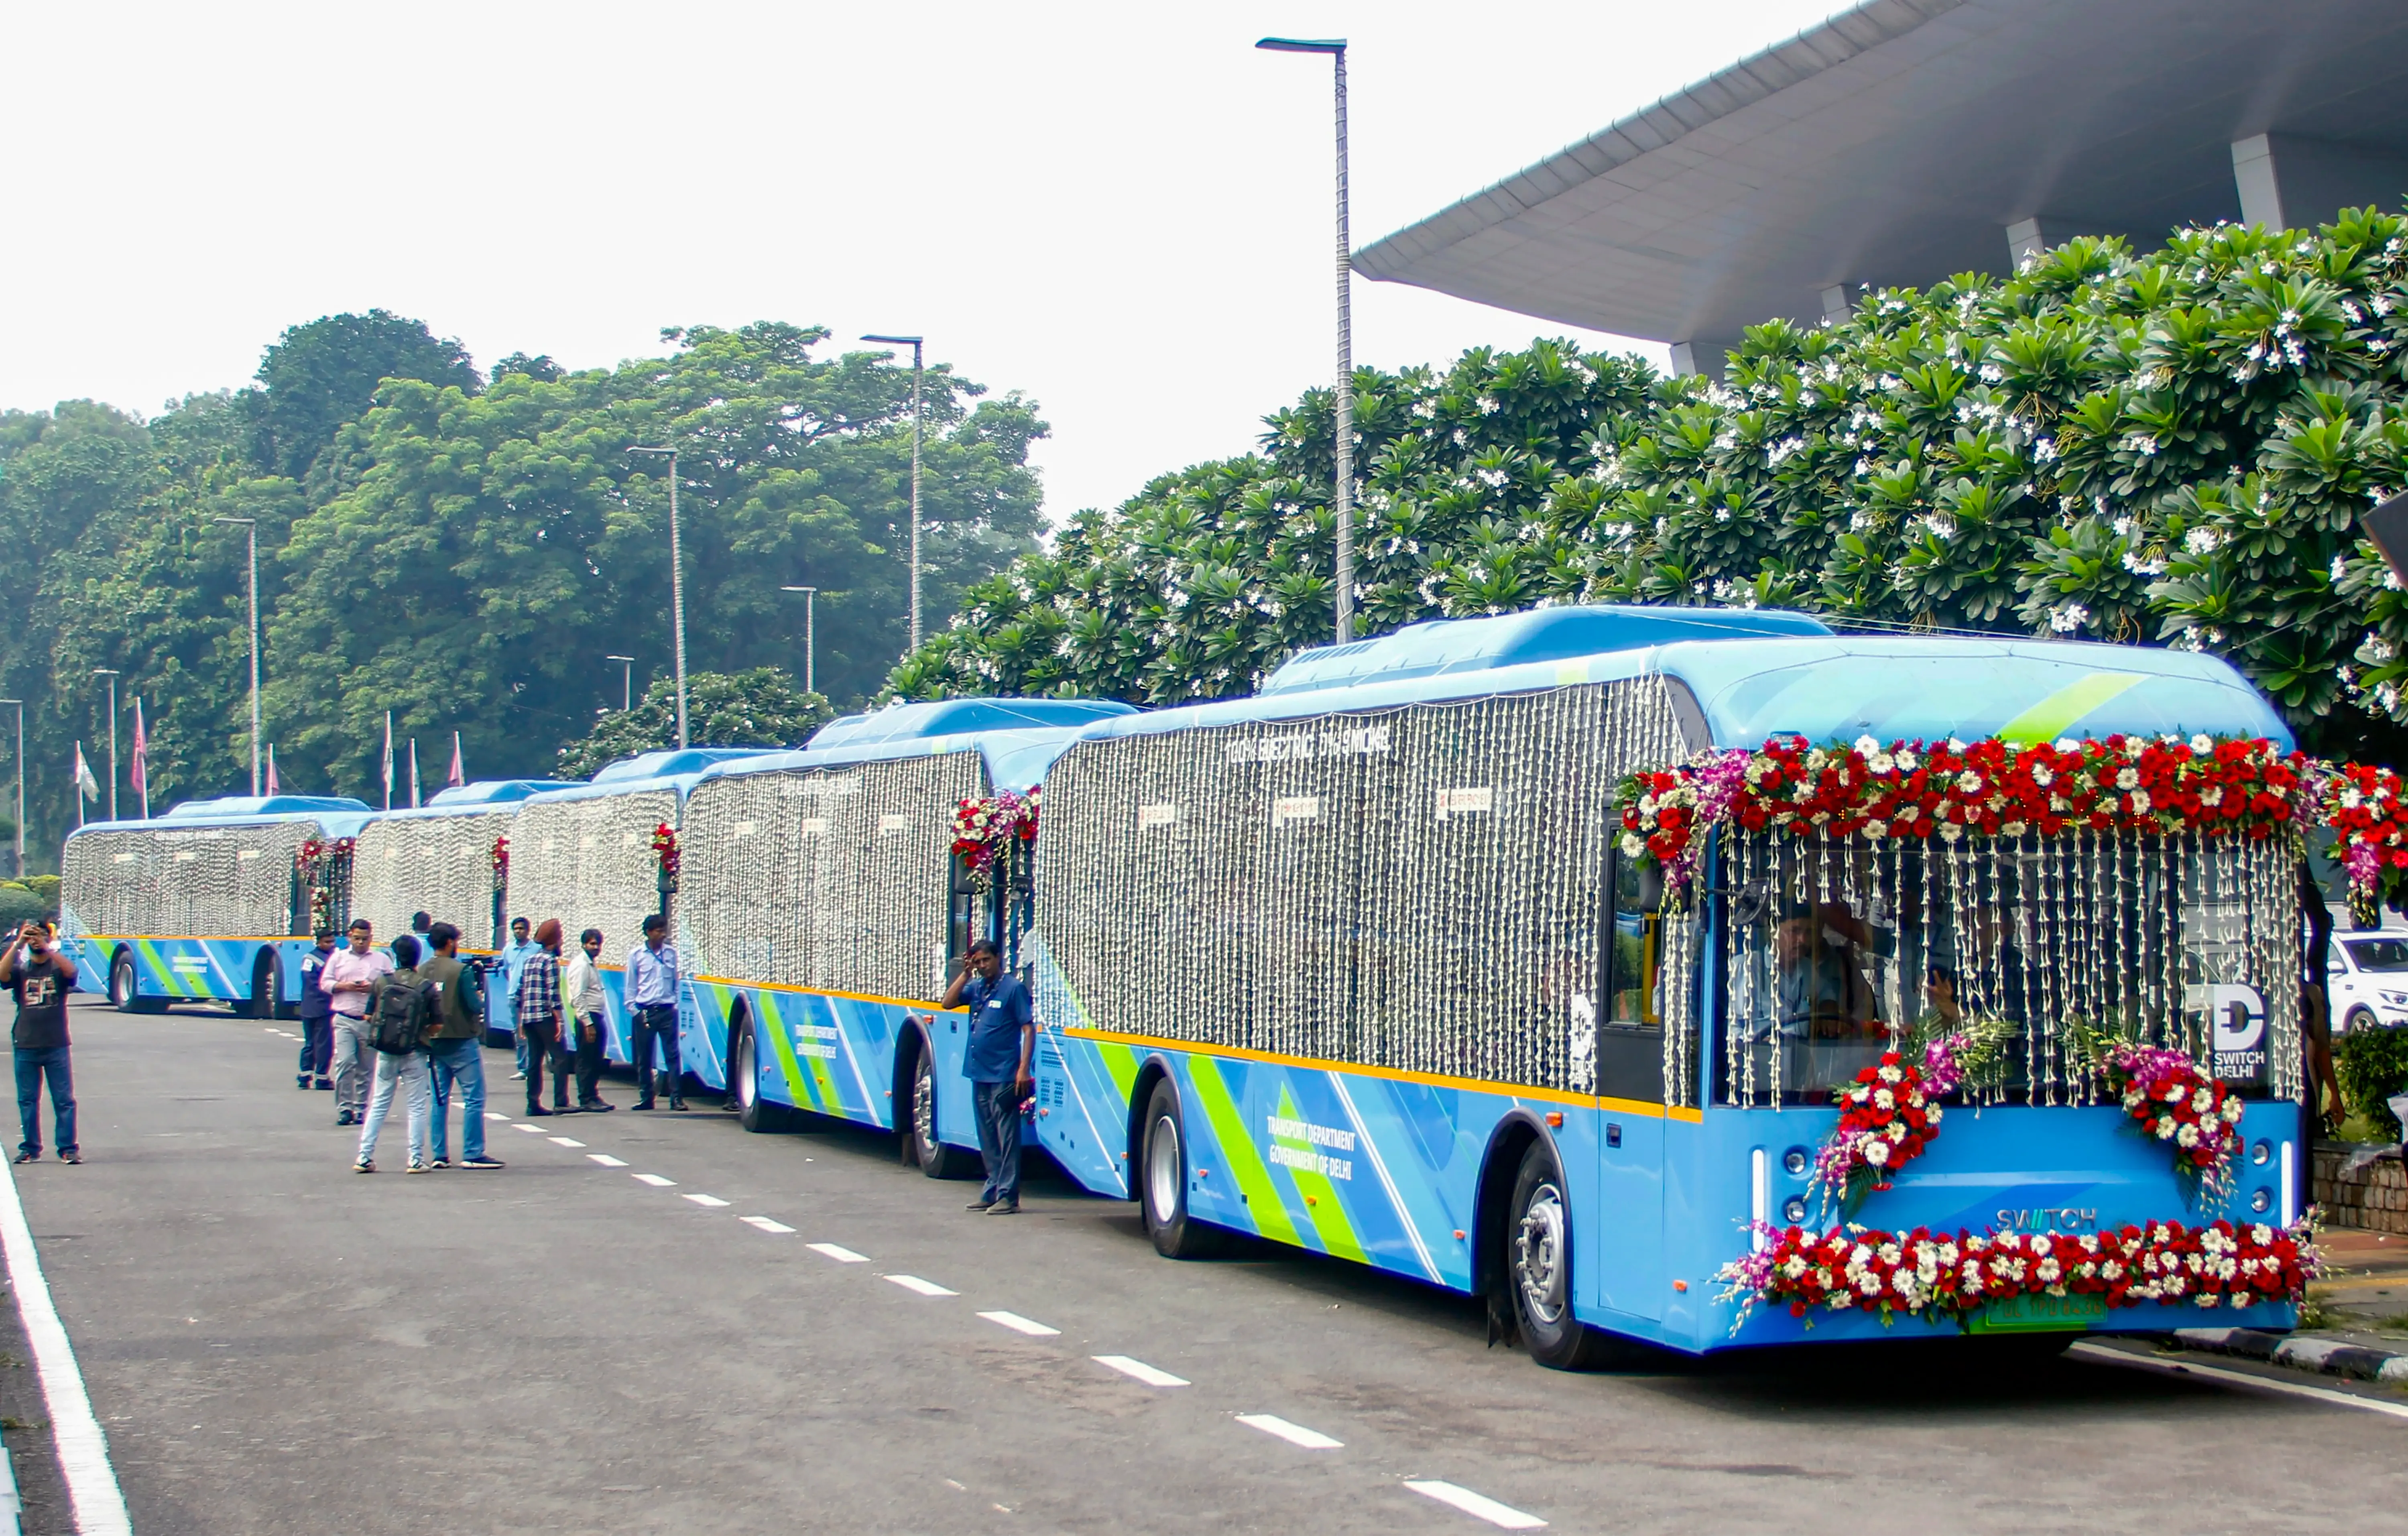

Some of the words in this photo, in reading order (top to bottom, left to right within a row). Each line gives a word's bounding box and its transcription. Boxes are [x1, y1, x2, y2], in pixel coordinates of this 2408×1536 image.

[2214, 1051, 2264, 1064] SWITCH
[2215, 1065, 2253, 1078] DELHI
[1267, 1116, 1307, 1141] TRANSPORT
[1308, 1123, 1355, 1151] DEPARTMENT
[1270, 1144, 1317, 1172] GOVERNMENT
[1318, 1154, 1328, 1174] OF
[1329, 1156, 1352, 1180] DELHI
[1997, 1208, 2097, 1229] SWITCH
